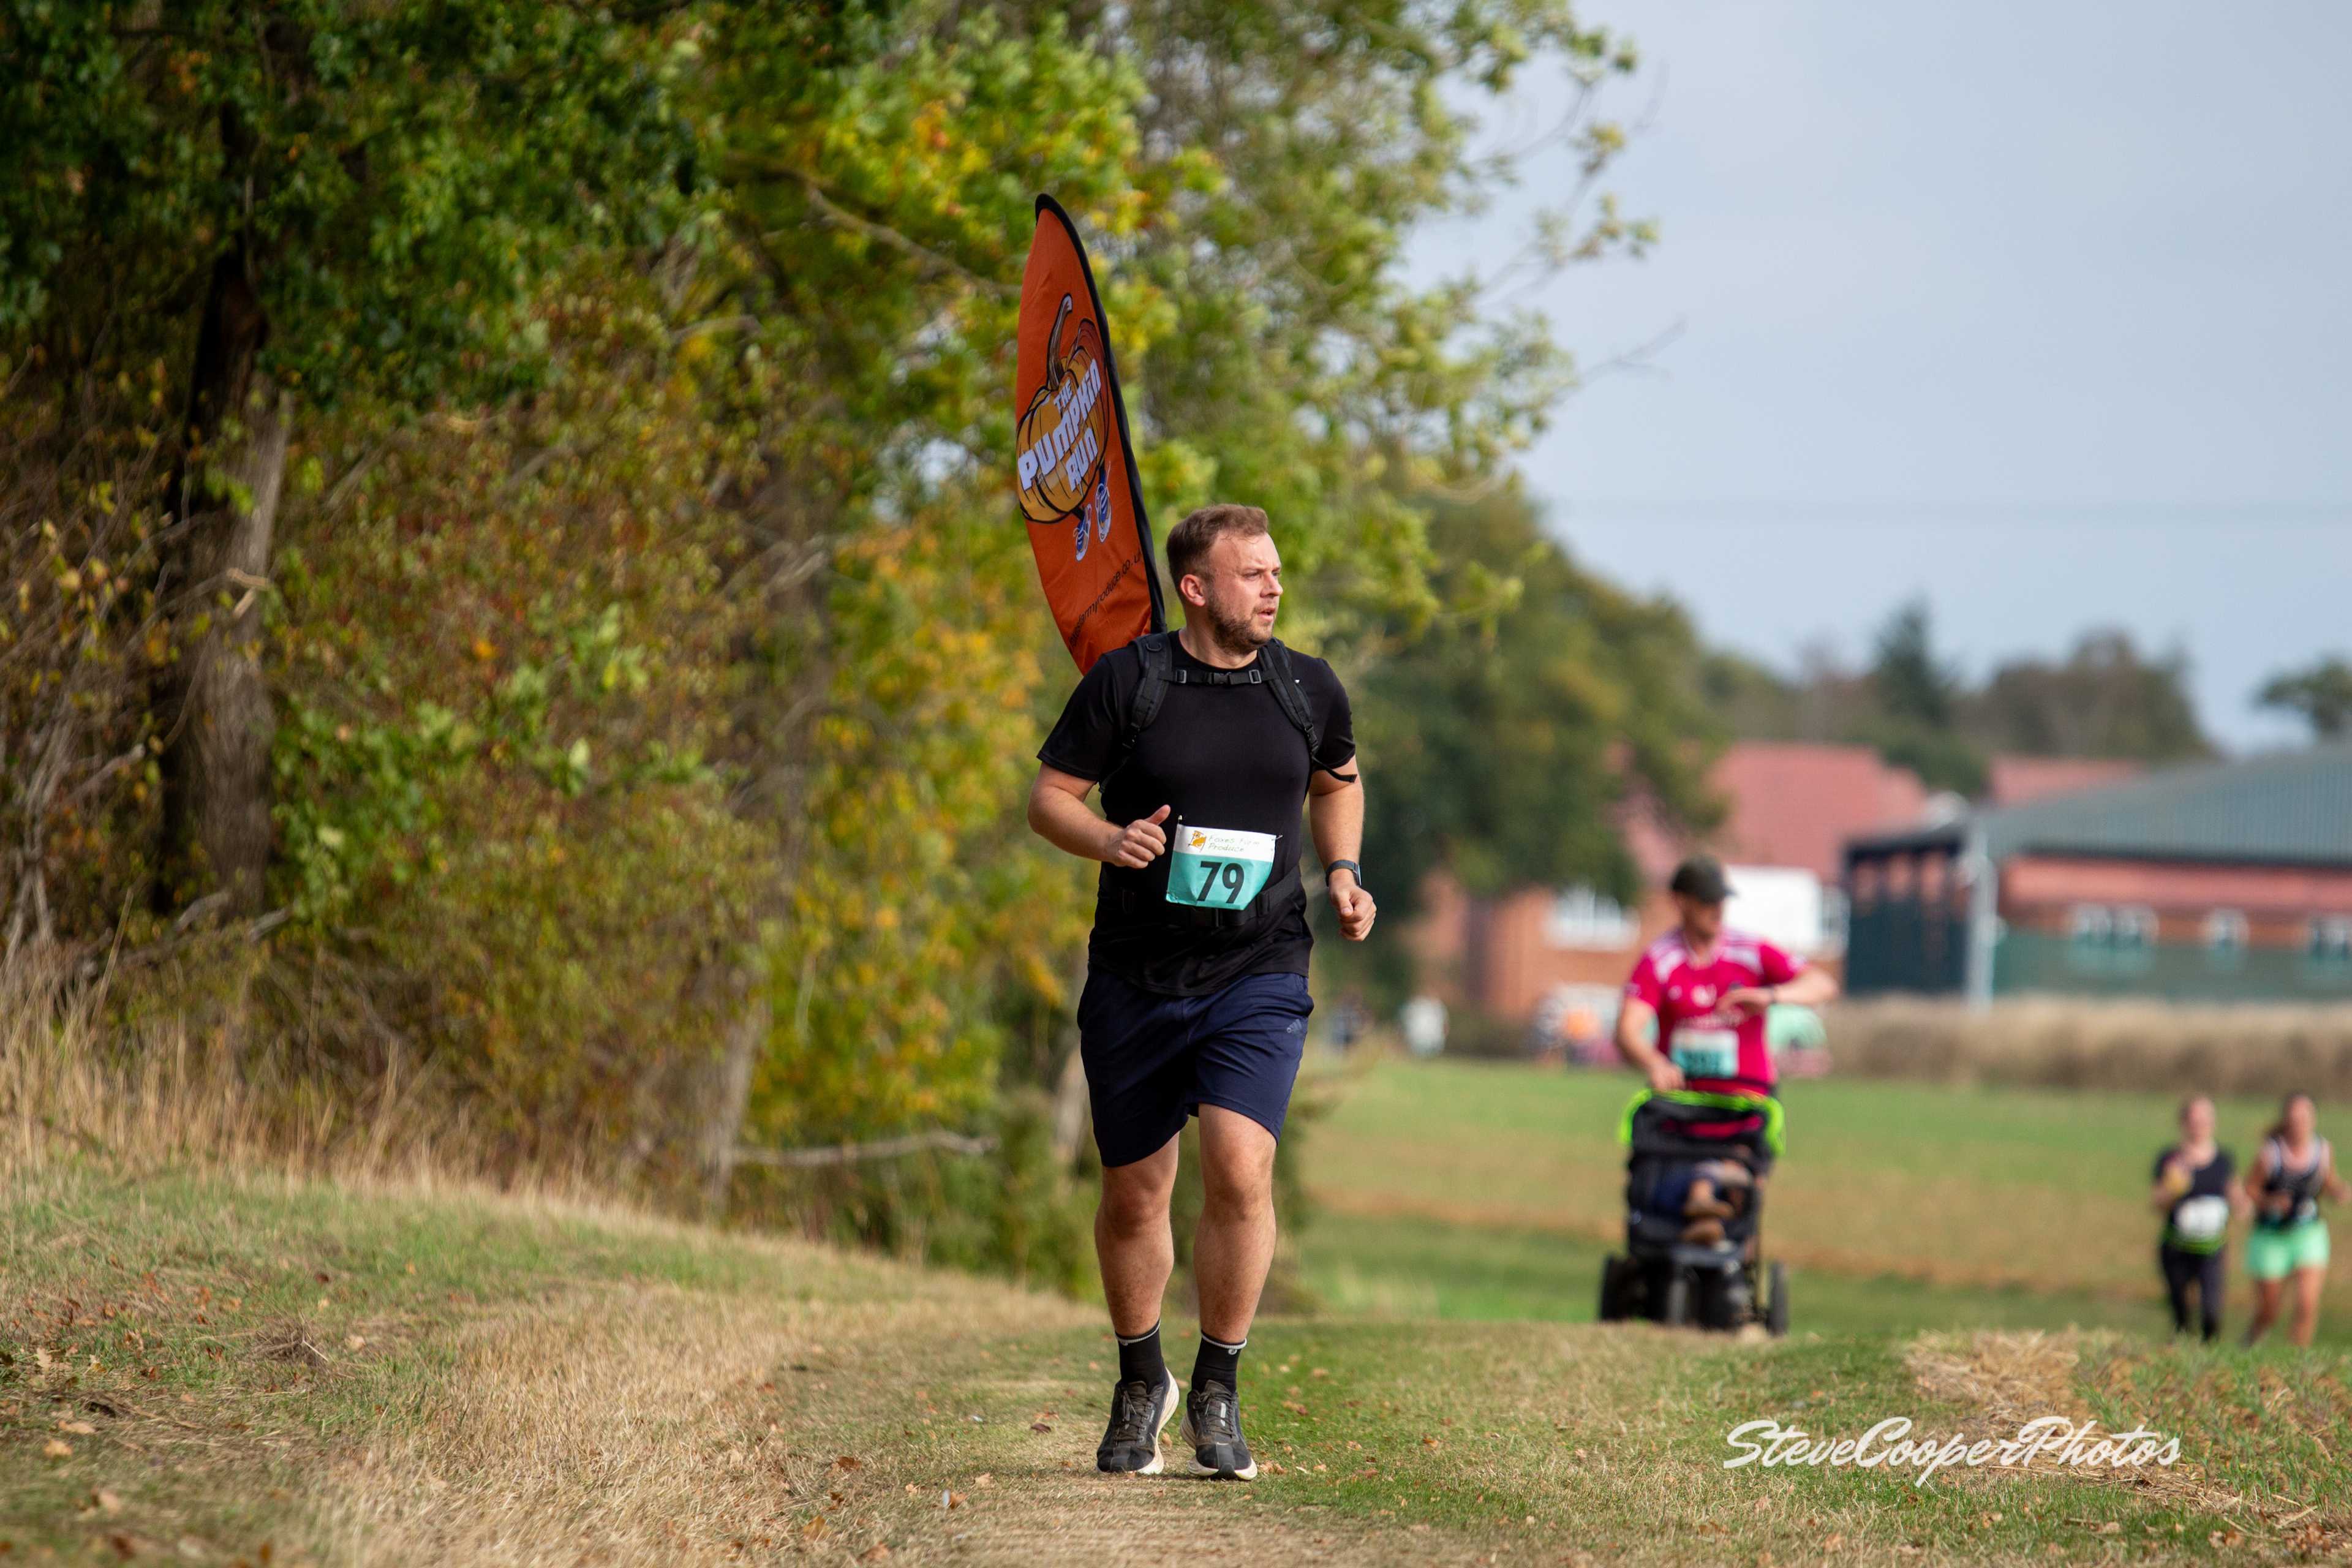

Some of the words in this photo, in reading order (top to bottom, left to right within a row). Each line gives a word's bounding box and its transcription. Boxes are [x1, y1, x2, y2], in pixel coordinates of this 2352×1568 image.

[1054, 378, 1073, 414] THE
[1066, 427, 1098, 492] RUN
[1208, 835, 1235, 843] Foxes
[1208, 842, 1244, 853] Produce
[1197, 861, 1245, 904] 79
